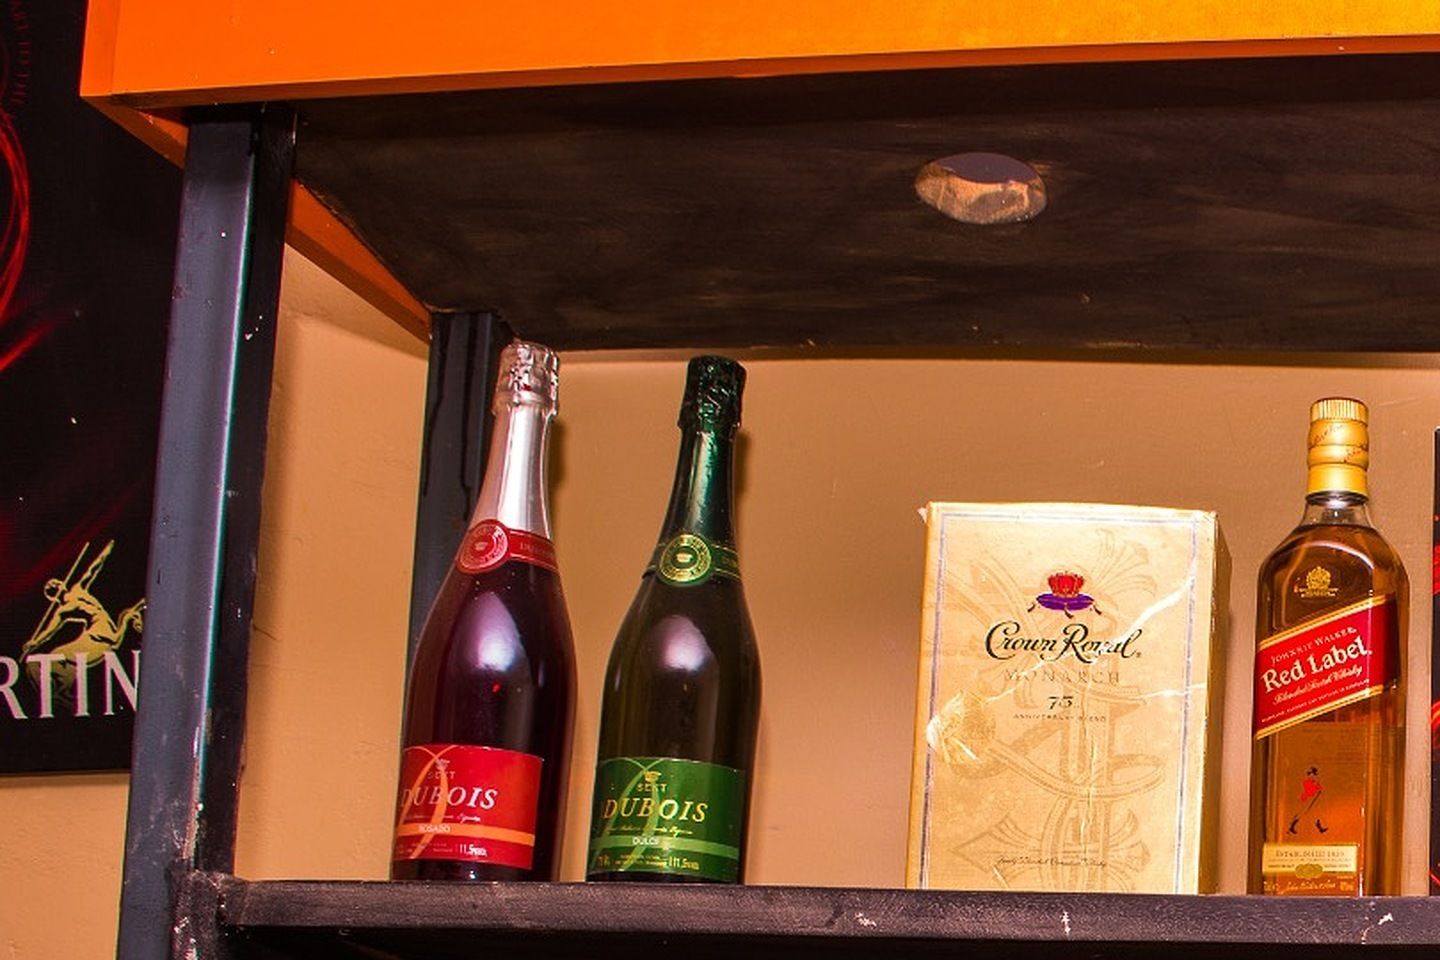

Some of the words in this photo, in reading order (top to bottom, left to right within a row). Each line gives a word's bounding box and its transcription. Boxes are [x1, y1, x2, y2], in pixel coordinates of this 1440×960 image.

[986, 621, 1058, 660] Crown
[1271, 641, 1312, 666] JOHNNIE
[1315, 627, 1357, 647] WALKER
[1261, 660, 1306, 693] Red
[1307, 636, 1368, 674] Label
[402, 786, 498, 810] DUBOIS
[603, 797, 709, 822] DUBOIS
